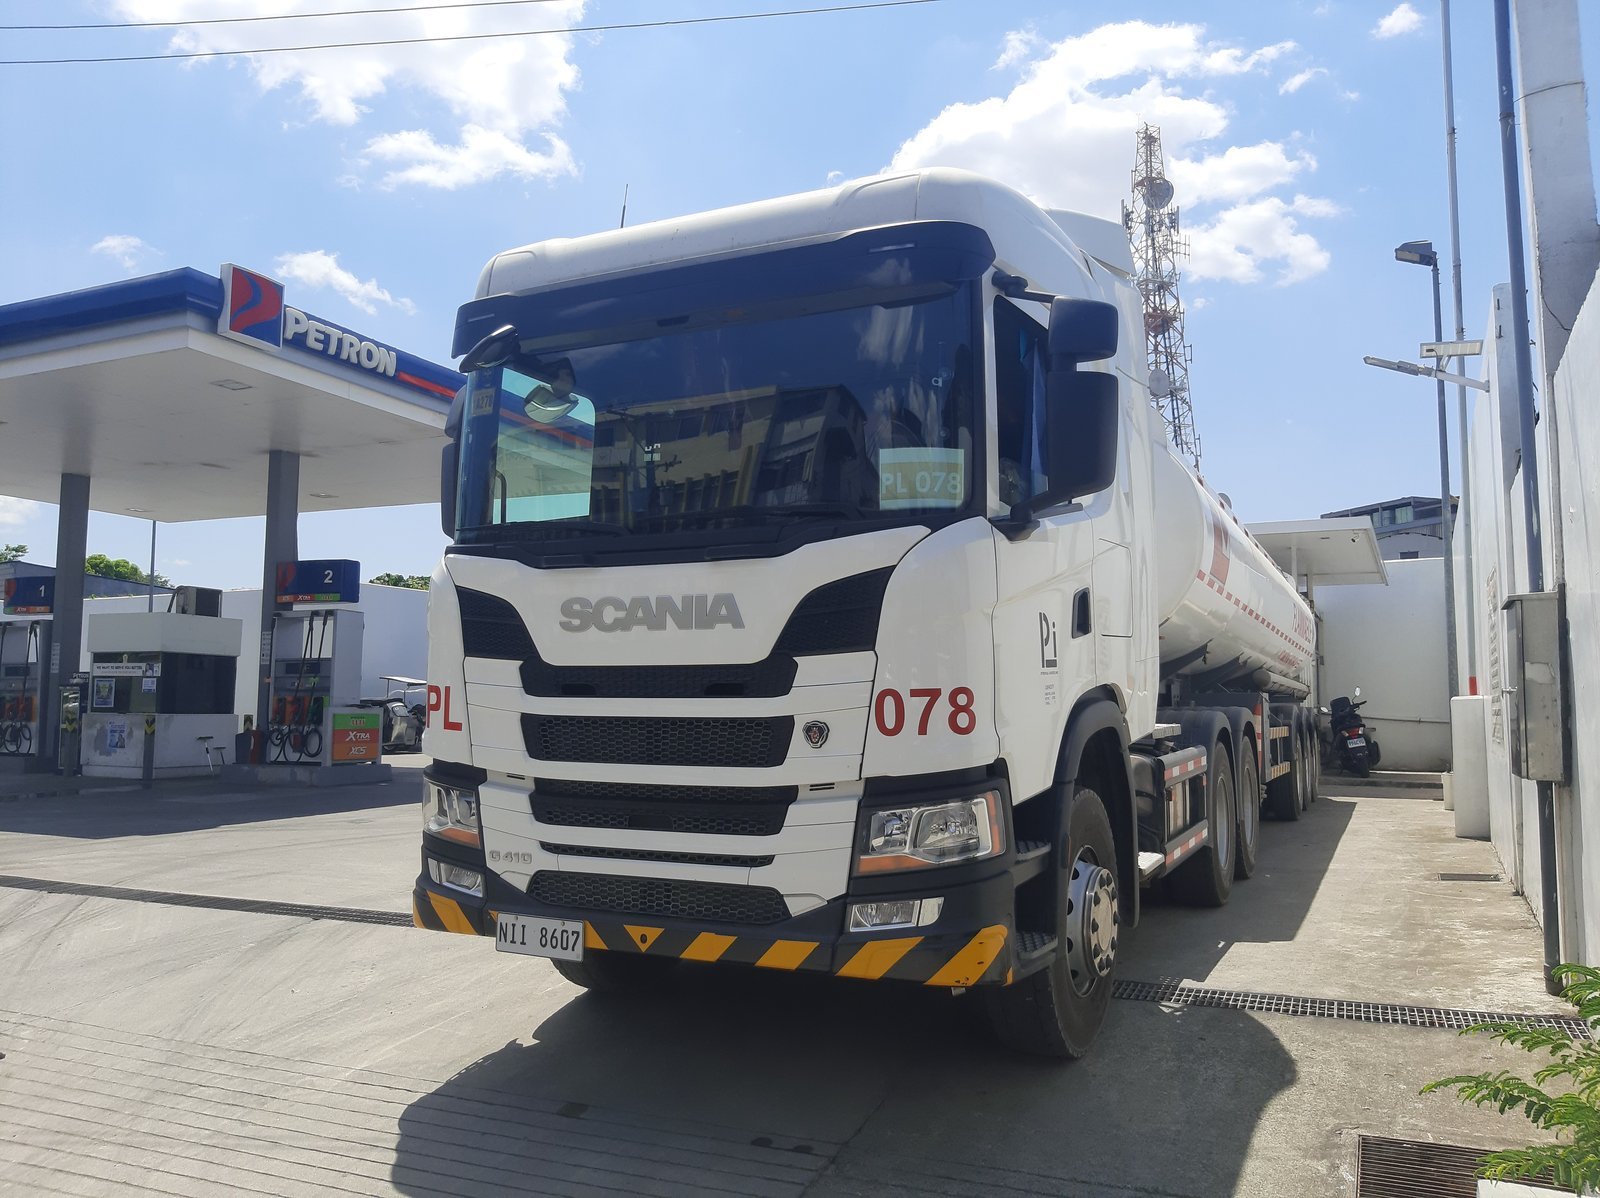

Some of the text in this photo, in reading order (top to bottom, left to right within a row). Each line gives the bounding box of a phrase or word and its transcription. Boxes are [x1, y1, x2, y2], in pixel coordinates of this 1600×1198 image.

[283, 307, 396, 377] PETRON
[881, 471, 961, 494] PL 078
[39, 585, 45, 597] 1
[324, 570, 333, 583] 2
[558, 592, 746, 633] SCANIA
[427, 684, 463, 731] PL
[874, 687, 977, 737] 078
[345, 731, 371, 741] XTRA
[498, 921, 580, 952] NII 8607
